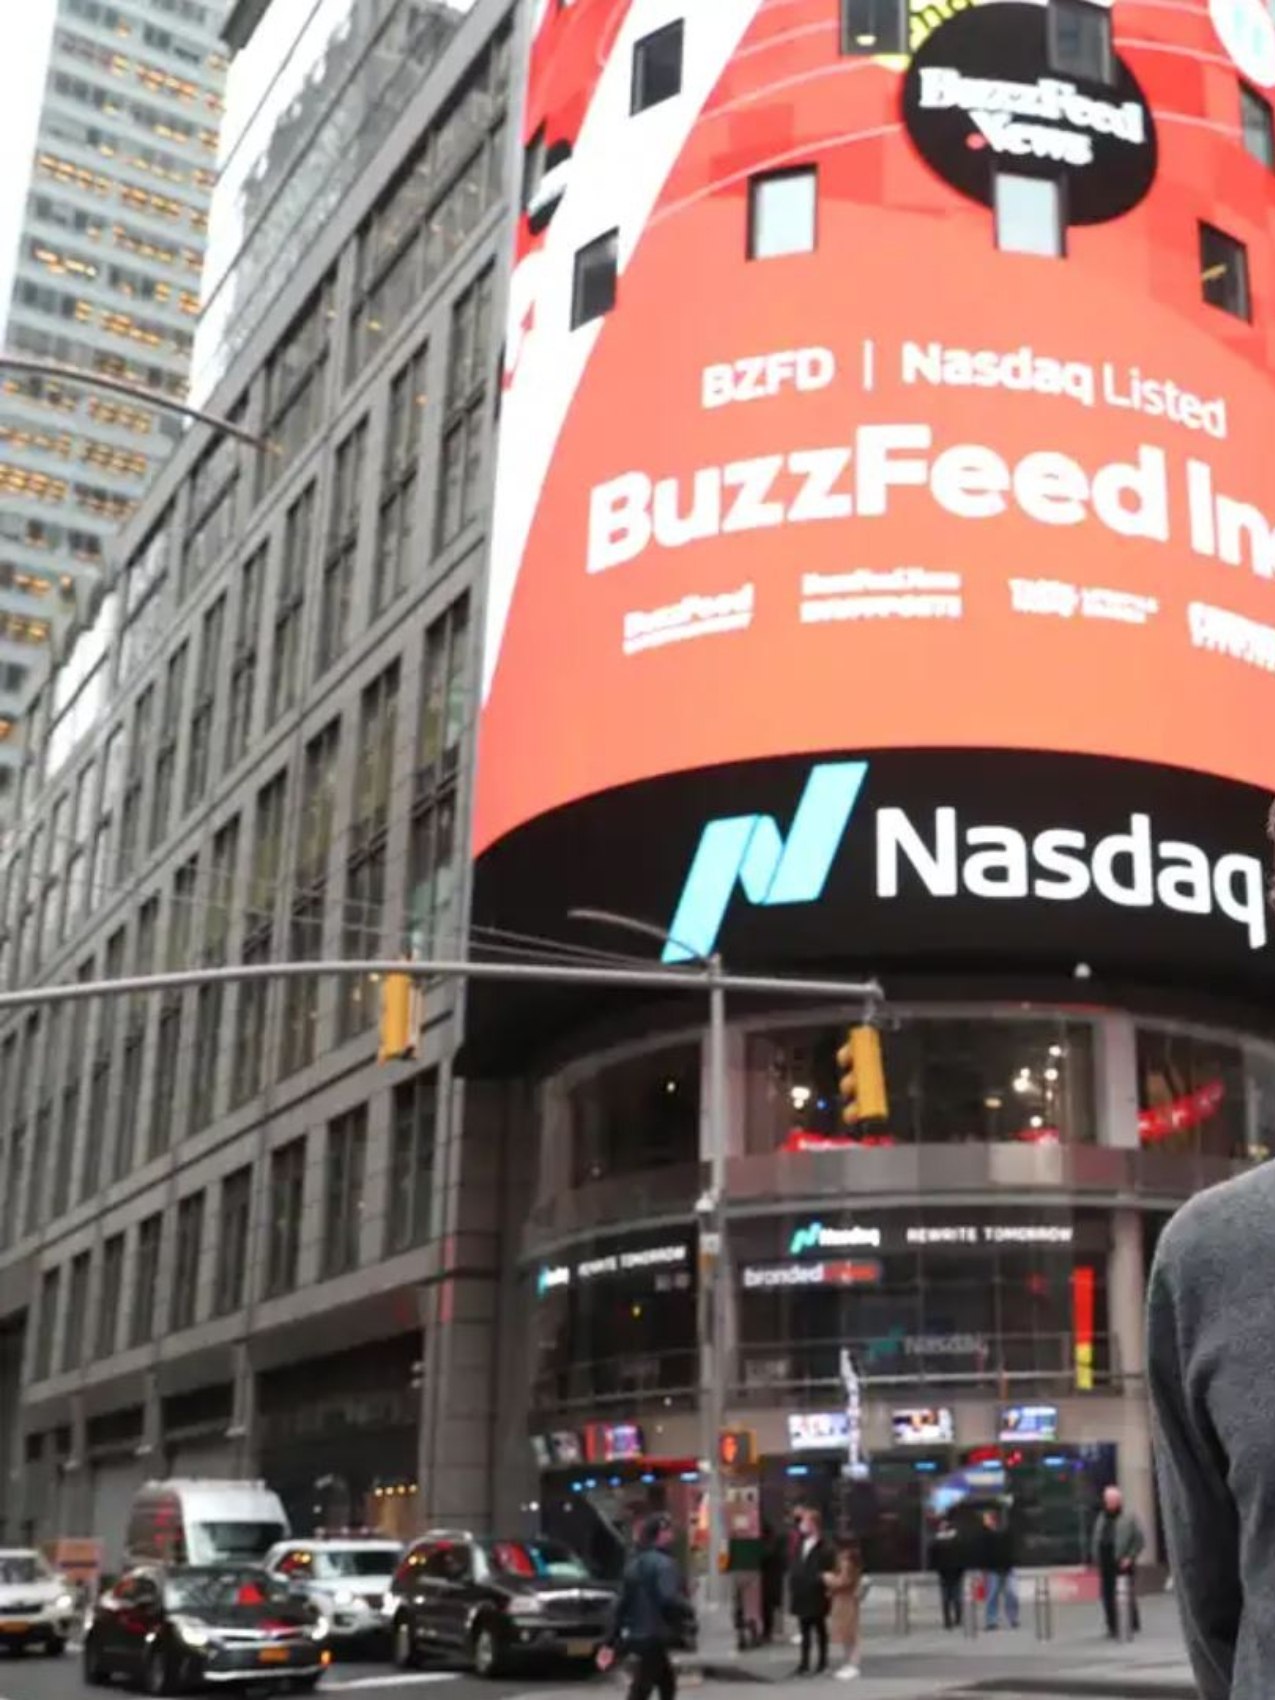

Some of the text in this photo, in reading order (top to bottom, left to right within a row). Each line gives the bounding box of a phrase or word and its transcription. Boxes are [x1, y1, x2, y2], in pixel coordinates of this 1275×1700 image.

[702, 347, 836, 409] BZFD
[901, 342, 1095, 406] Nasdaq
[1102, 363, 1227, 439] Listed
[586, 424, 1170, 573] BuzzFeed
[876, 806, 1267, 949] Nasdaq
